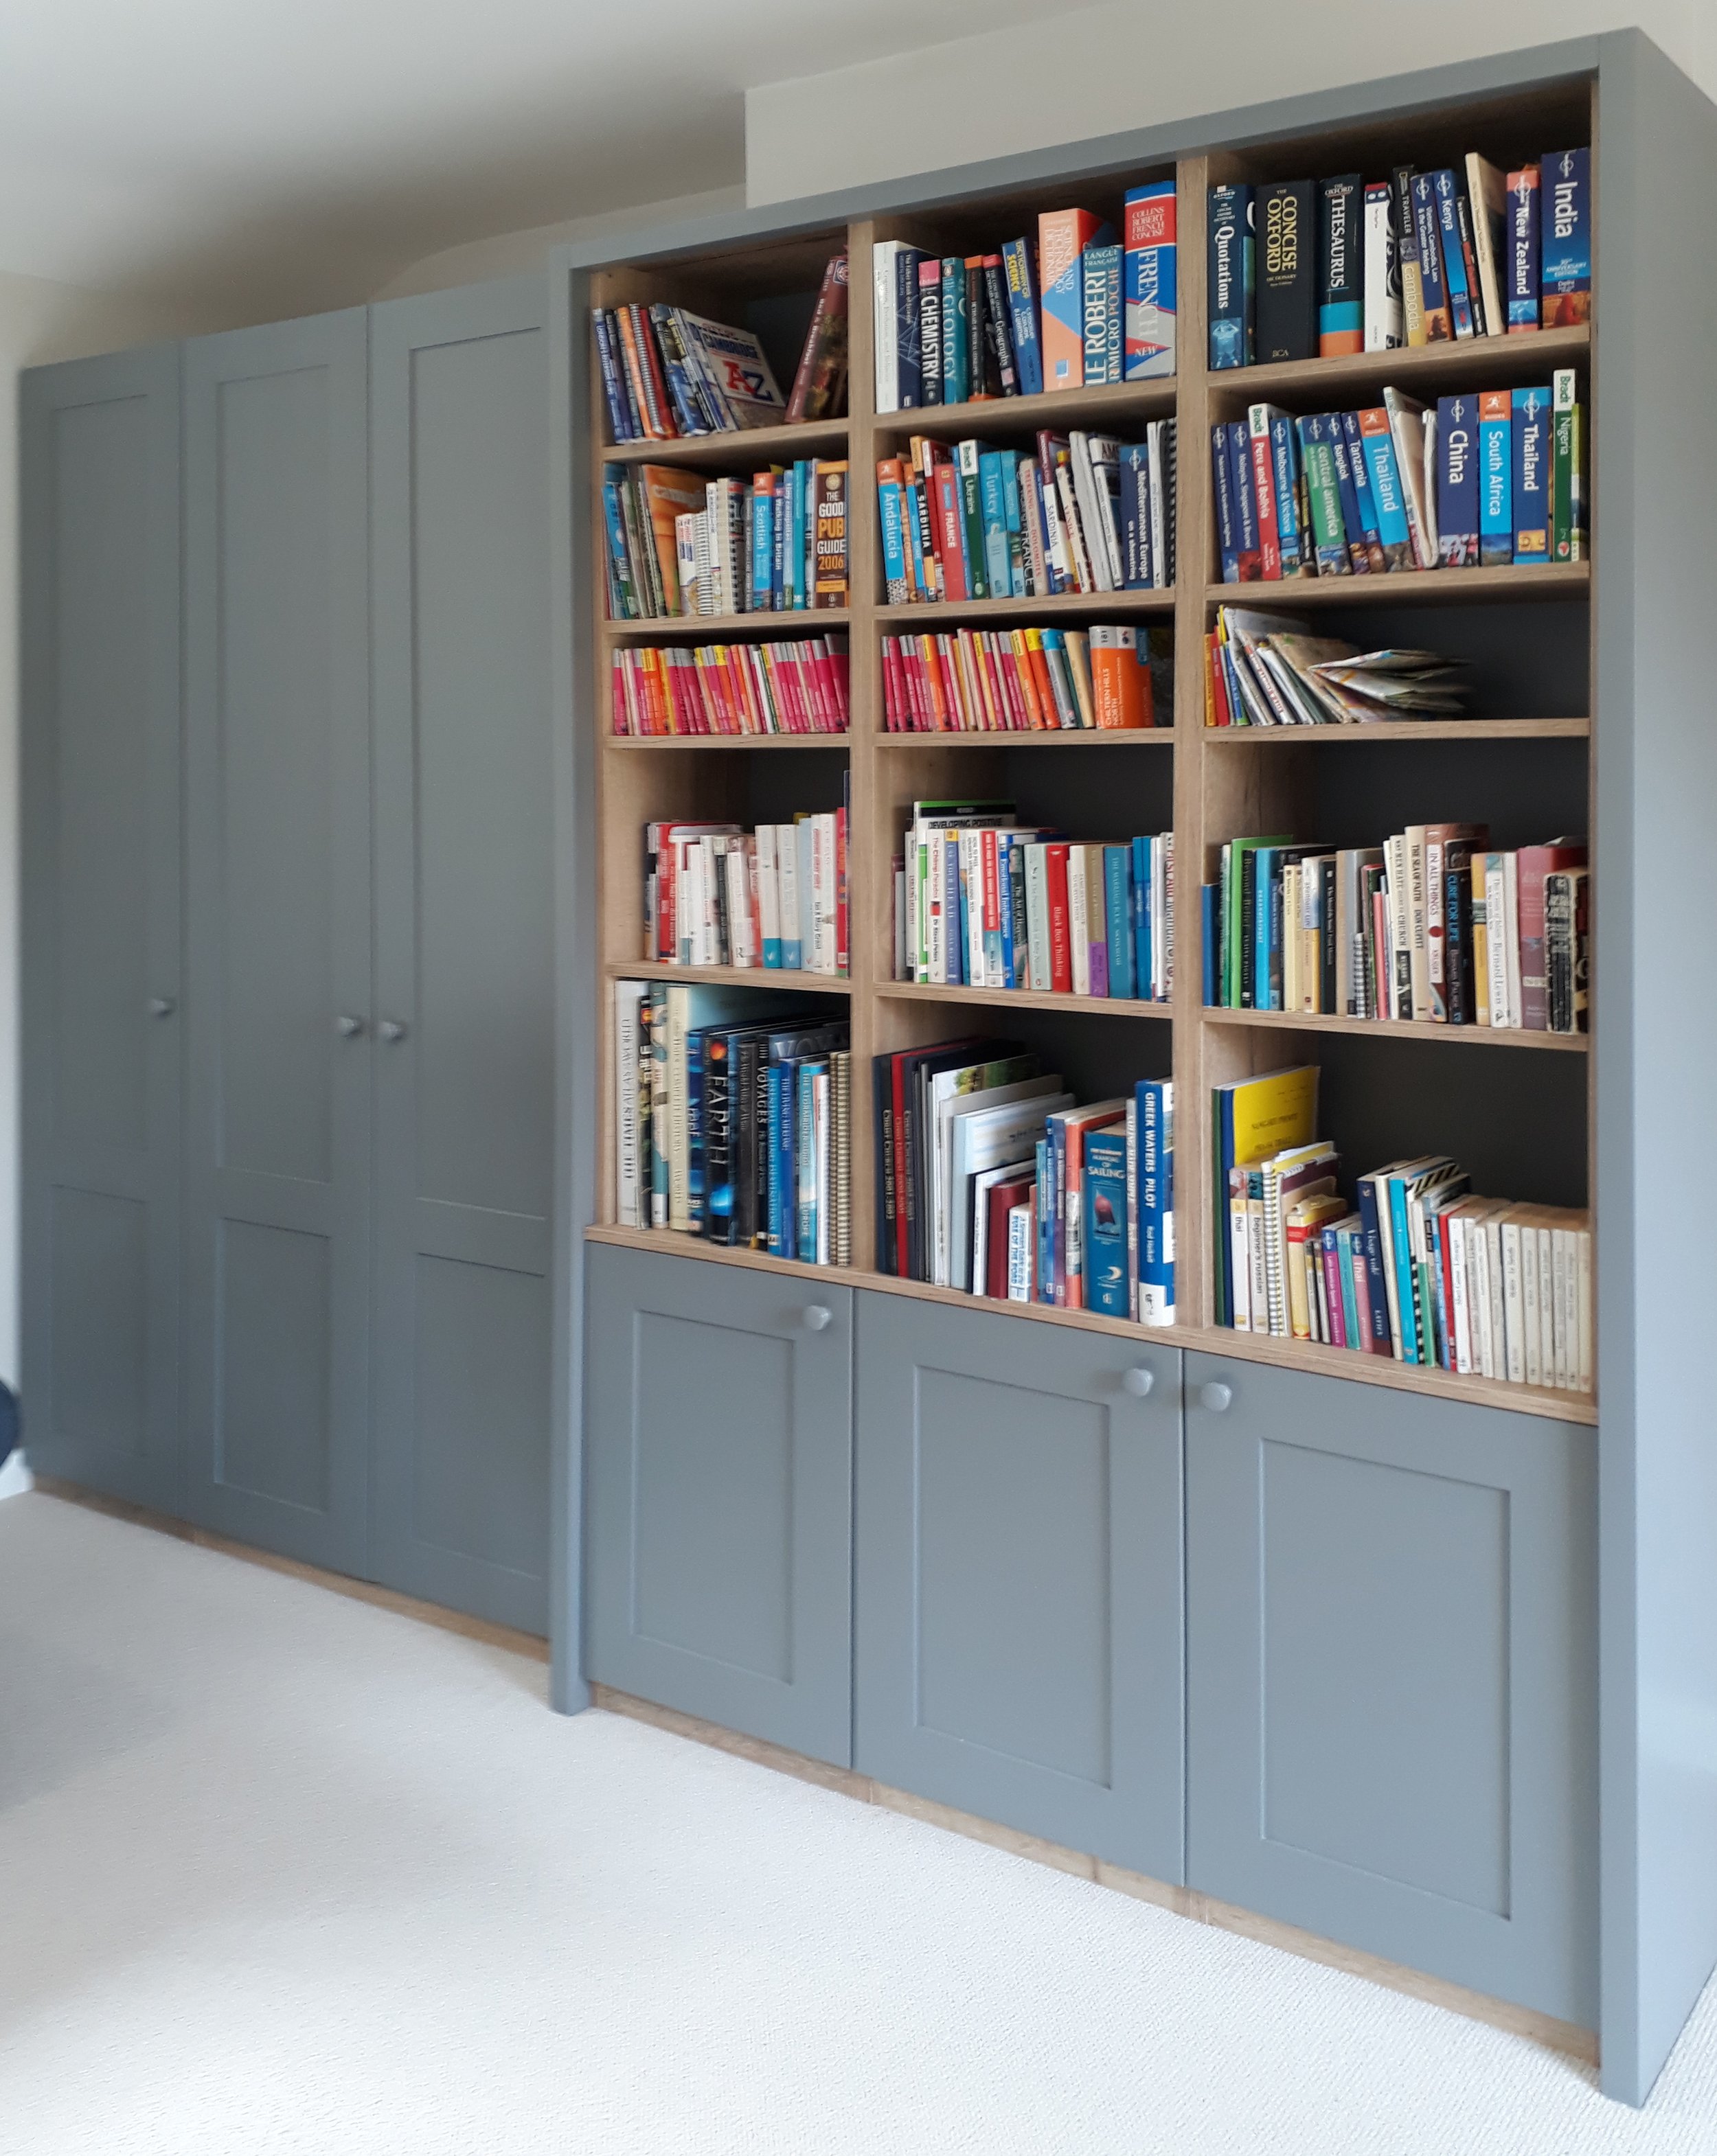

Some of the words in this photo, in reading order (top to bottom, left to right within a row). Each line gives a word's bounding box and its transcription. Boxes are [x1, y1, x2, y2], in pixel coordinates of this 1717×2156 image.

[1325, 185, 1354, 196] OXFORD
[1132, 207, 1164, 219] COLLINS
[1132, 214, 1164, 226] ROBERT
[1401, 195, 1413, 235] TRAVELER
[1442, 199, 1455, 231] Kenya
[1515, 207, 1529, 238] New
[1554, 181, 1579, 239] India
[1132, 222, 1164, 233] FRENCH
[1132, 228, 1164, 240] CONCISE
[1267, 198, 1282, 273] OXFORD
[1282, 196, 1297, 271] CONCISE
[1331, 195, 1345, 288] THESAURUS
[1419, 225, 1428, 248] Greater
[1045, 228, 1054, 286] DICTIONARY
[1055, 227, 1065, 294] TECHNOLOGY
[1065, 225, 1073, 264] SCIENCE
[1084, 249, 1118, 260] LANGUE
[1015, 241, 1027, 284] DICTIONARY
[1021, 286, 1030, 299] OF
[1065, 267, 1073, 290] AND
[1214, 225, 1235, 309] Quotations
[1420, 249, 1431, 275] Mekong
[1516, 241, 1530, 295] Zealand
[1108, 268, 1119, 315] POCHE
[1138, 249, 1159, 336] FRENCH
[1403, 266, 1420, 332] cambodia
[1084, 269, 1107, 355] ROBERT
[803, 325, 819, 367] Breakfast
[920, 295, 940, 379] CHEMISTRY
[944, 295, 956, 381] GEOLOGY
[995, 321, 1009, 366] Geography
[1108, 319, 1119, 364] MICRO
[1135, 345, 1158, 357] NEW
[1272, 349, 1290, 358] BCA
[1085, 358, 1107, 386] LE
[1559, 376, 1571, 403] Bradt
[1253, 408, 1262, 433] Bradt
[1557, 417, 1571, 455] Nigeria
[1255, 442, 1264, 465] Peru
[1318, 446, 1334, 487] central
[1334, 444, 1349, 481] Bangkok
[1350, 440, 1367, 488] Tanzania
[1448, 429, 1468, 484] China
[1488, 430, 1503, 471] South
[1523, 424, 1540, 491] Thailand
[1257, 466, 1266, 484] and
[1277, 446, 1288, 491] Melbourne
[1372, 444, 1399, 512] Thailand
[818, 501, 844, 518] GOOD
[826, 491, 840, 501] THE
[965, 479, 976, 515] Ukraine
[986, 473, 998, 514] Turkey
[1136, 470, 1148, 542] Mediterranean
[1258, 486, 1271, 519] Bolivia
[1281, 492, 1288, 501] &
[1488, 474, 1504, 516] Africa
[756, 505, 766, 549] Scottish
[774, 498, 782, 531] Walking
[817, 517, 844, 538] PUB
[884, 492, 900, 559] Andalucía
[917, 494, 931, 549] SARDINIA
[944, 512, 956, 549] FRANCE
[1046, 504, 1059, 548] SARDINIA
[1128, 520, 1135, 531] on
[1325, 490, 1339, 538] america
[775, 543, 783, 571] Britain
[817, 538, 846, 555] GUIDE
[817, 555, 844, 571] 2006
[1021, 531, 1034, 588] FRANCE
[1031, 529, 1042, 577] DOLOMITES
[1127, 540, 1136, 580] shoestring
[1139, 544, 1149, 580] Europe
[1104, 689, 1112, 726] CHILTERN
[1111, 697, 1119, 726] NORTH
[929, 819, 970, 829] DEVELOPING
[1411, 845, 1420, 858] THE
[1412, 860, 1421, 871] SEA
[1430, 853, 1439, 864] IN
[1431, 865, 1440, 882] ALL
[1448, 875, 1458, 898] CURE
[1413, 882, 1422, 902] FAITH
[1431, 883, 1440, 916] THINGS
[1001, 897, 1010, 939] Intelligence
[1414, 909, 1422, 924] DON
[1448, 901, 1458, 919] FOR
[1398, 915, 1407, 946] CHURCH
[1415, 925, 1424, 950] CUPITT
[1450, 922, 1459, 942] LIFE
[1054, 945, 1063, 978] Thinking
[1493, 942, 1503, 978] Bernard
[1494, 980, 1503, 1005] Lewis
[756, 1066, 767, 1124] VOYAGES
[1144, 1092, 1155, 1127] GREEK
[708, 1076, 729, 1165] EARTH
[883, 1109, 892, 1138] CHRIST
[1145, 1129, 1156, 1173] WATERS
[1087, 1166, 1126, 1179] SAILING
[1144, 1178, 1156, 1208] PILOT
[801, 1204, 810, 1237] EUROPE
[1011, 1235, 1018, 1246] OF
[1253, 1217, 1263, 1261] beginner's
[1366, 1229, 1378, 1257] Visage
[1255, 1263, 1264, 1294] russian
[1354, 1261, 1365, 1283] Thai
[1369, 1258, 1381, 1275] volé
